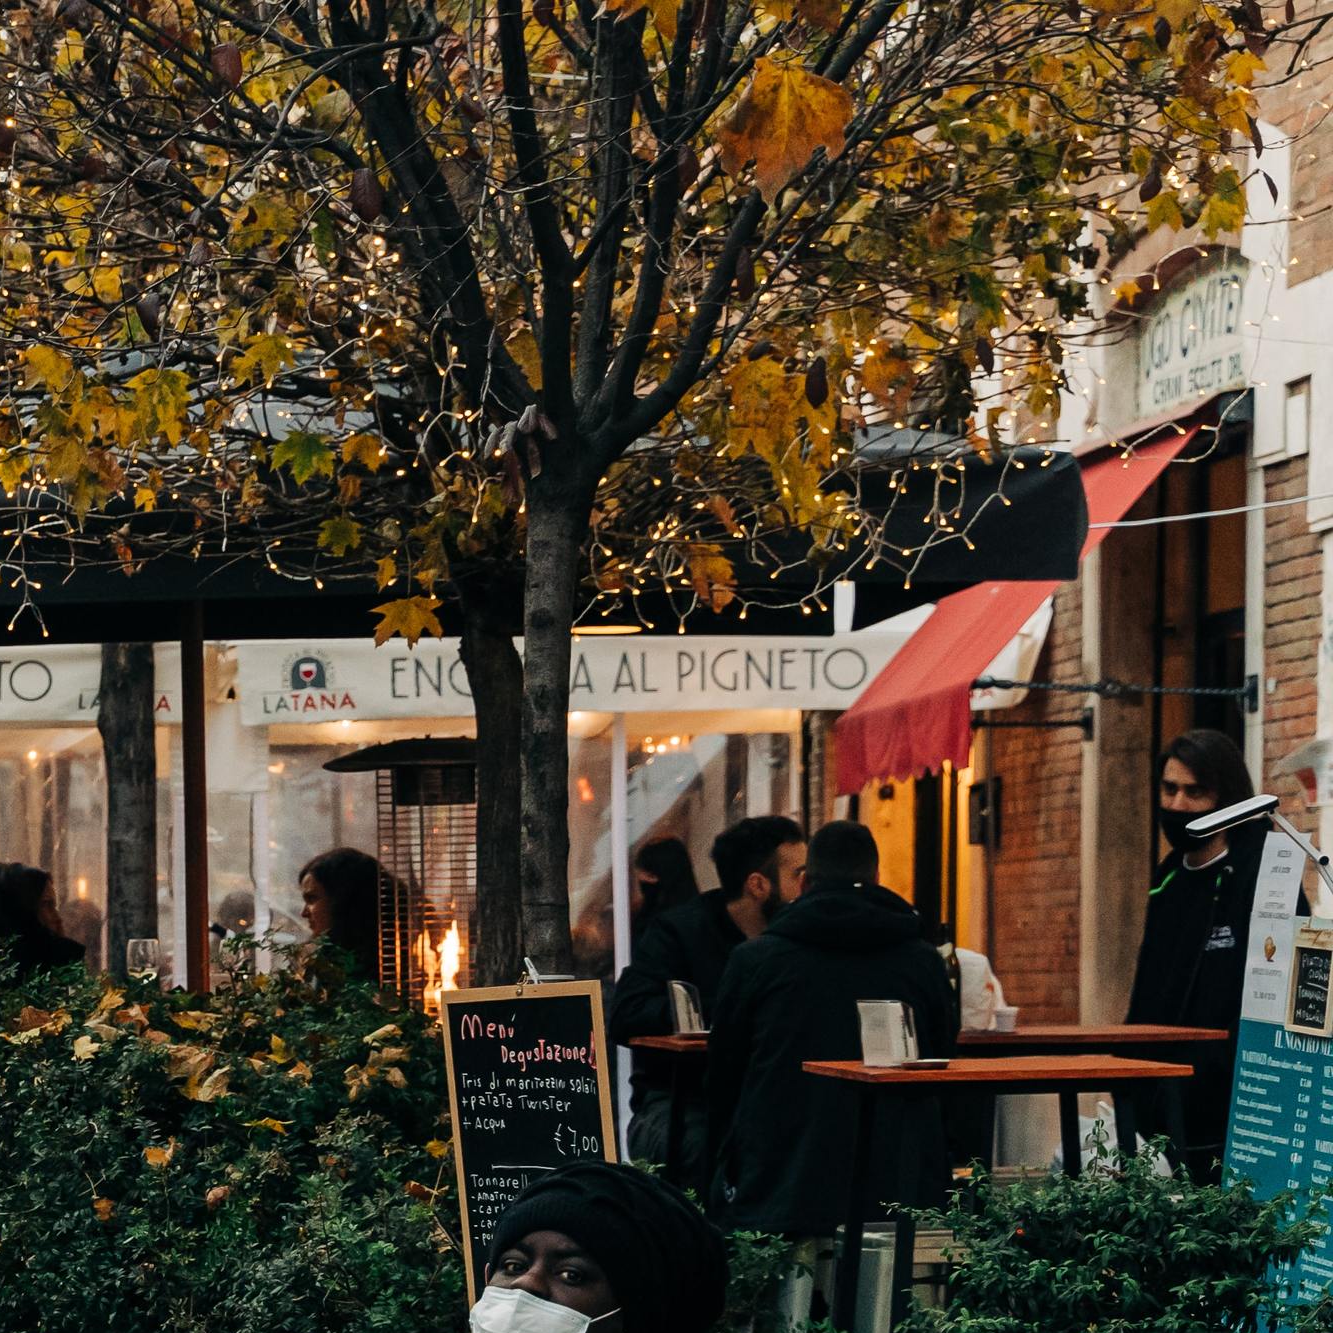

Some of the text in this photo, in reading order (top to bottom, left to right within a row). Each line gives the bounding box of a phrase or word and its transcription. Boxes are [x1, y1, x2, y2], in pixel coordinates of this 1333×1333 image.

[613, 651, 659, 694] AL
[678, 647, 868, 692] PIGNETO
[462, 1072, 482, 1089] Tris
[489, 1071, 500, 1090] di
